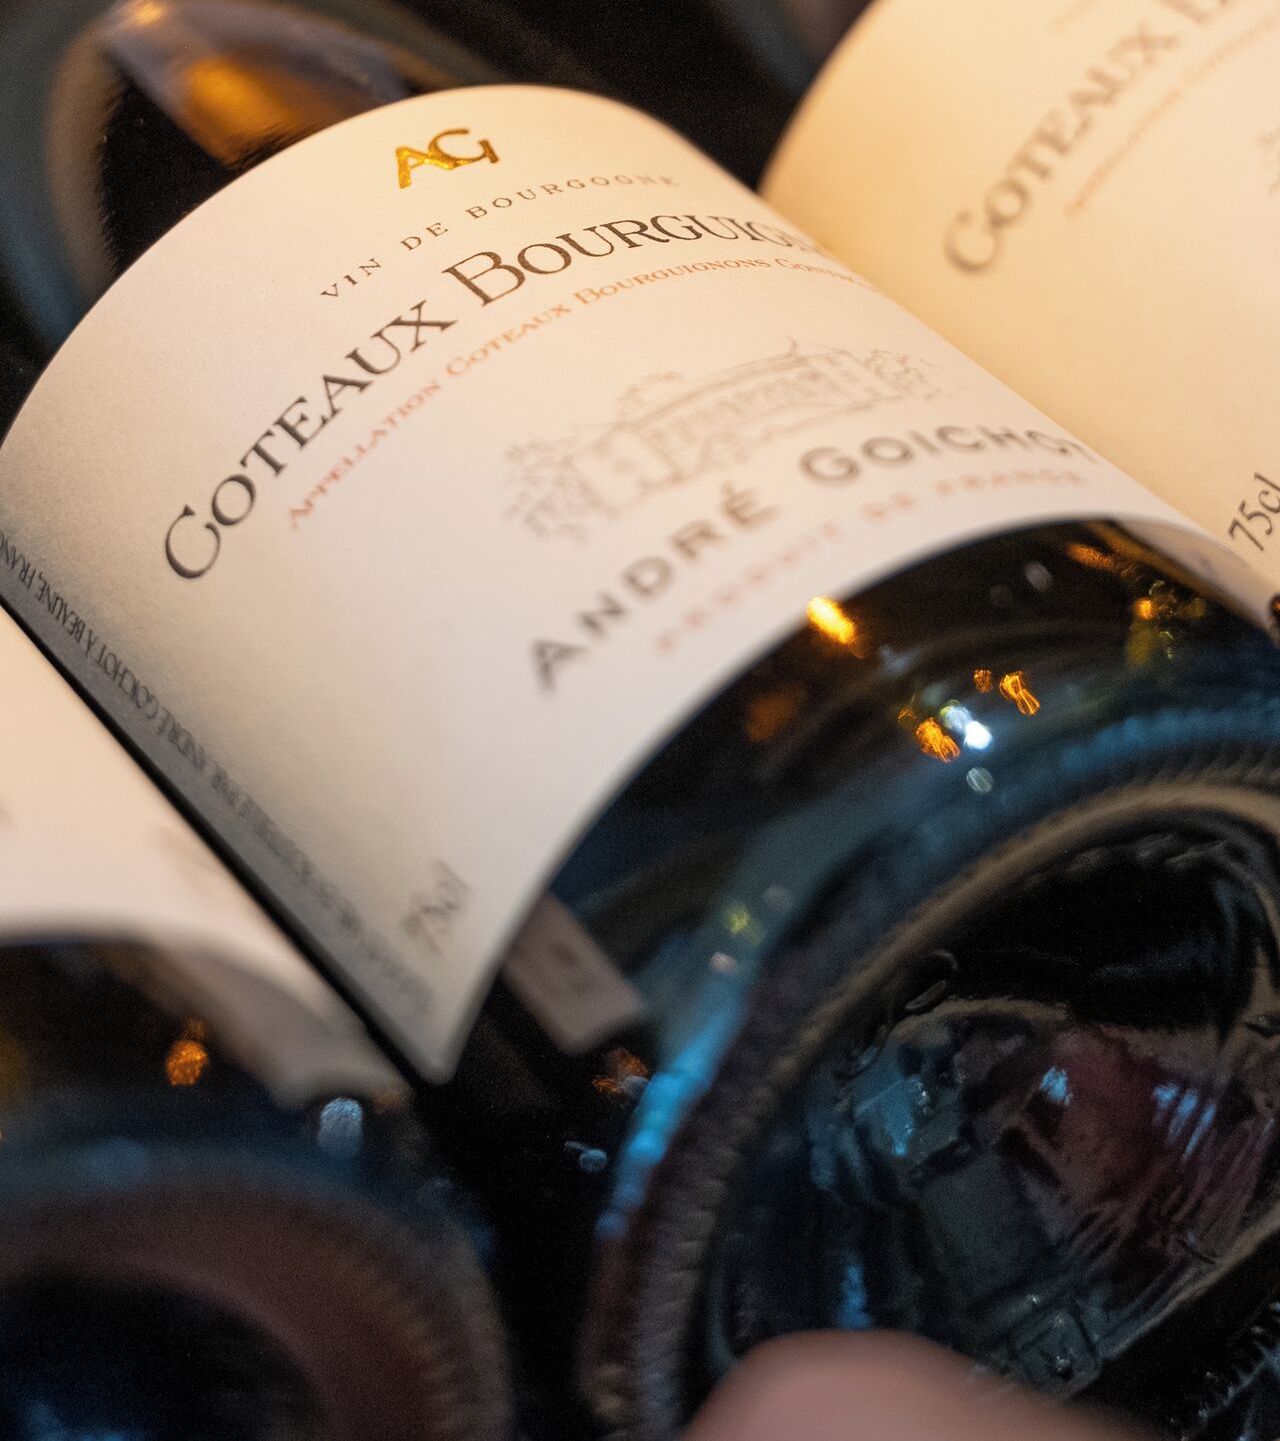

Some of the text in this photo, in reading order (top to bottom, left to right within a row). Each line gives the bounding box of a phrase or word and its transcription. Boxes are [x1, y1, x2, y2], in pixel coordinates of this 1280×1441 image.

[320, 172, 680, 301] VIN DE BOURGOGNE
[395, 128, 500, 189] AG
[941, 19, 1180, 277] COTEAUX
[164, 299, 459, 580] COTEAUX
[287, 377, 444, 532] APPELLATION
[445, 303, 572, 379] COTEAUX
[572, 255, 774, 306] BOURGUIGNONS
[96, 644, 159, 720] GOICHOT
[530, 480, 782, 694] ANDRÉ
